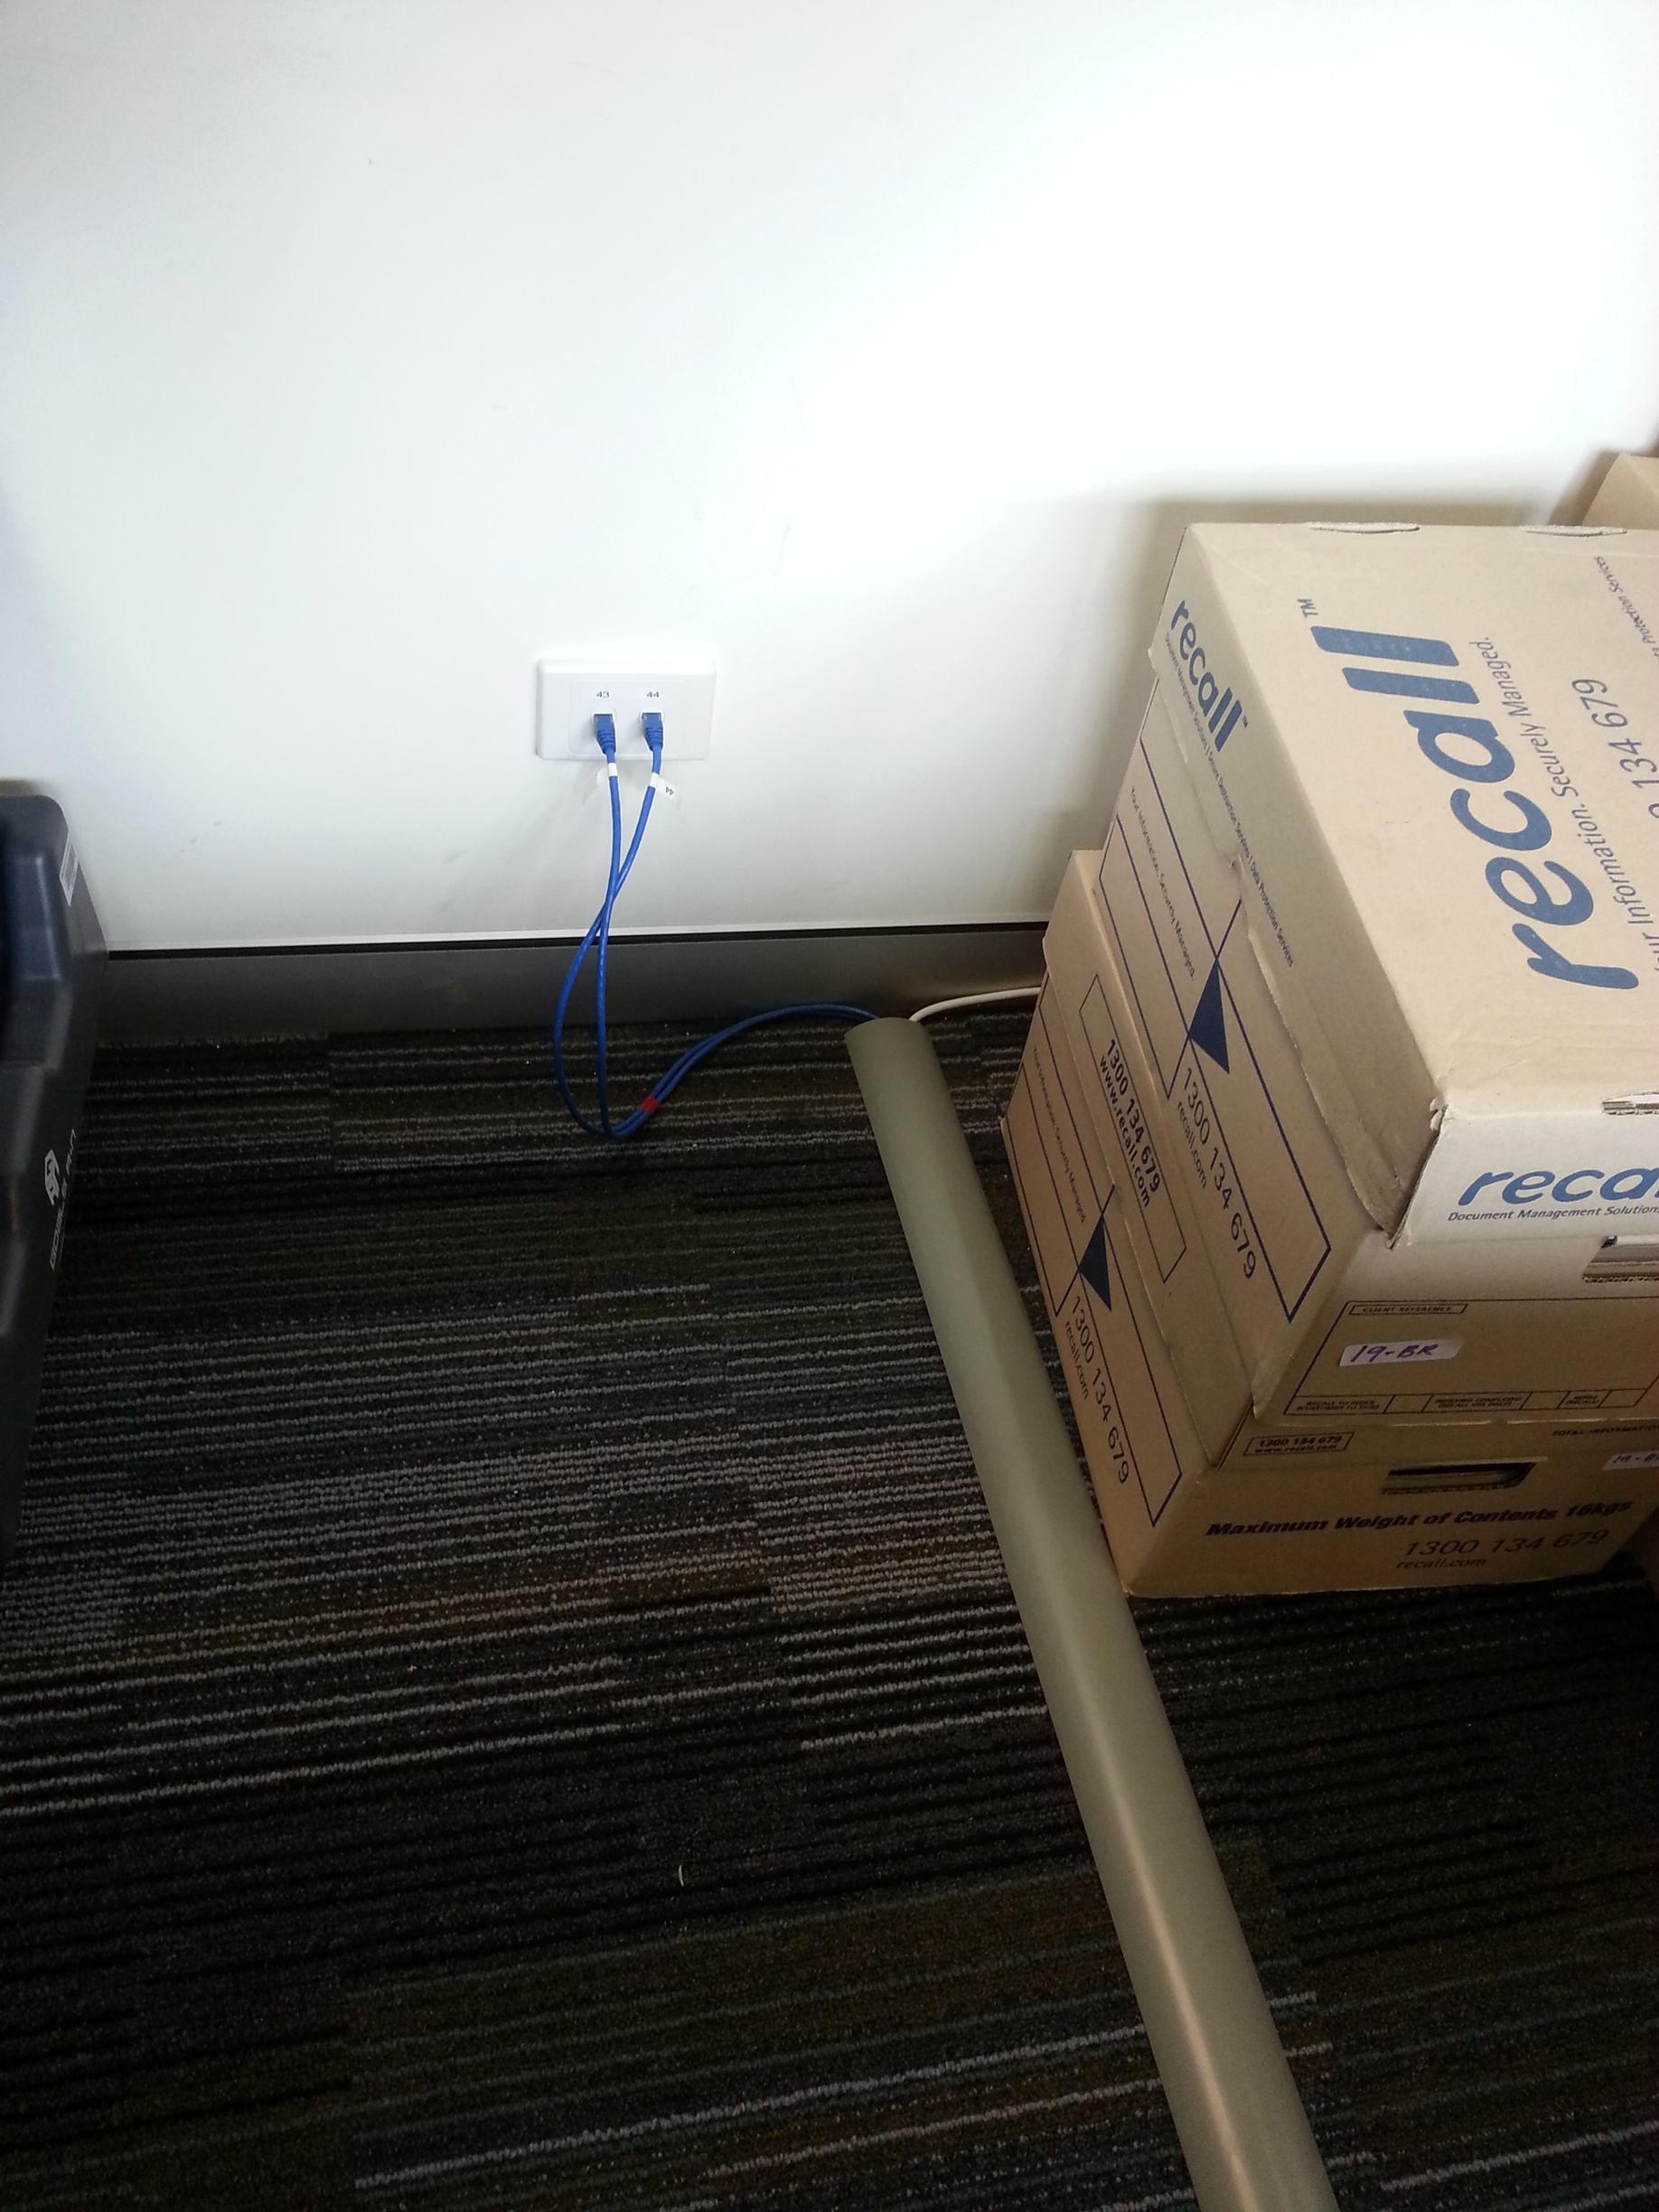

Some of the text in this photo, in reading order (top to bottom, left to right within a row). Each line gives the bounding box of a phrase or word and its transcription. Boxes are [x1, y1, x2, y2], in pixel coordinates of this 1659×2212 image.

[596, 690, 610, 698] 43
[646, 689, 660, 698] 44
[1171, 600, 1243, 753] recall
[1469, 636, 1532, 717] Managed.
[1520, 723, 1579, 797] Securely
[1571, 679, 1659, 790] 134 679
[1309, 624, 1639, 990] recall
[1571, 802, 1654, 924] Information.
[1100, 1054, 1150, 1208] www.recall.com
[1107, 1038, 1161, 1194] 1300 134 679
[1176, 1101, 1207, 1190] recall.com
[1184, 1067, 1257, 1279] 1300 134 679
[1457, 1167, 1659, 1206] reca
[1448, 1211, 1514, 1222] Document
[1517, 1206, 1602, 1220] Management
[1064, 1320, 1090, 1400] recall.com
[1072, 1296, 1129, 1484] 1300 134 679
[1205, 1520, 1329, 1536] Maximum
[1334, 1514, 1420, 1530] Weight
[1422, 1512, 1453, 1525] of
[1453, 1507, 1559, 1524] Contents
[1405, 1529, 1610, 1556] 1300 134 679
[1395, 1557, 1487, 1570] recall.com
